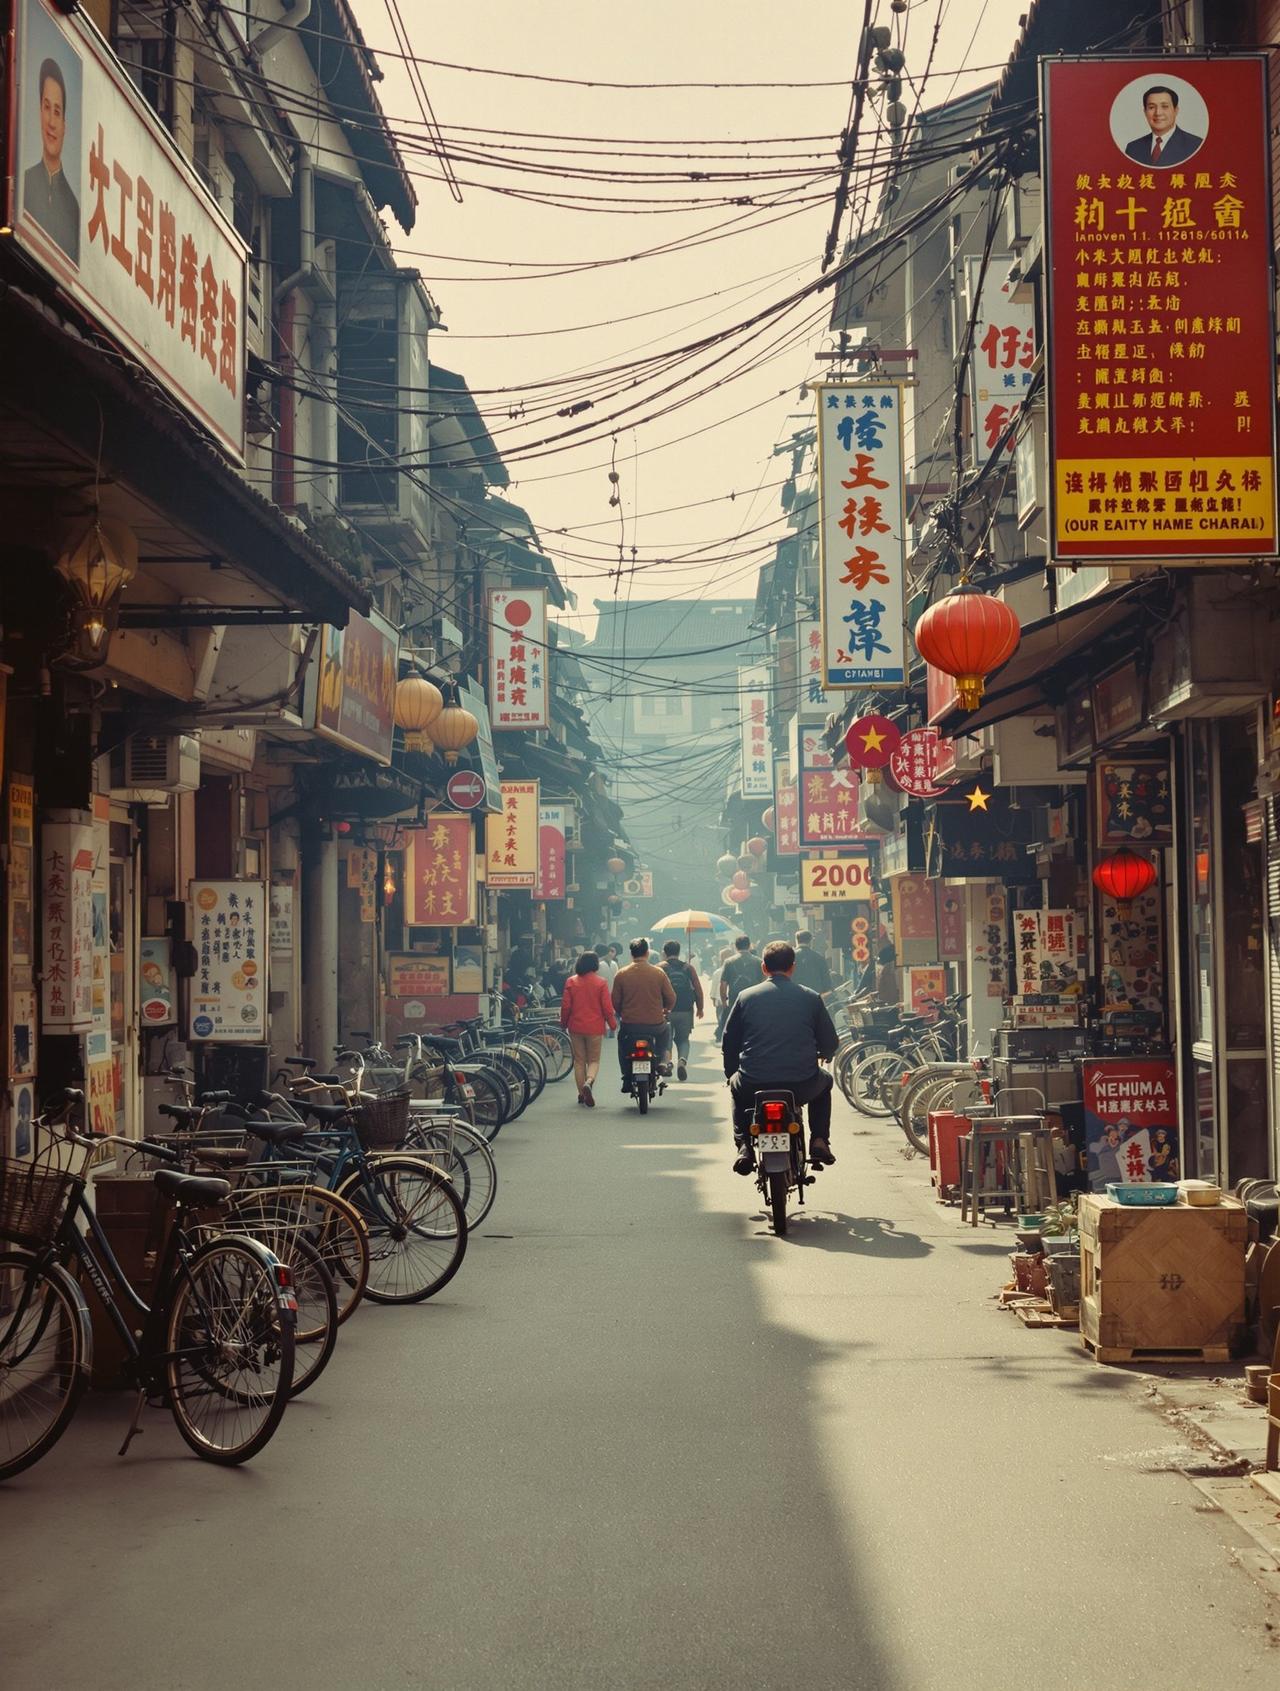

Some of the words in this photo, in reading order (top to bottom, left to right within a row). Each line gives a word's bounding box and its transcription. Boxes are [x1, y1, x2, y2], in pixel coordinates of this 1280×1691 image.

[1065, 518, 1098, 533] (OUR
[1153, 518, 1193, 530] HAME
[1095, 1081, 1166, 1097] NEHUMA
